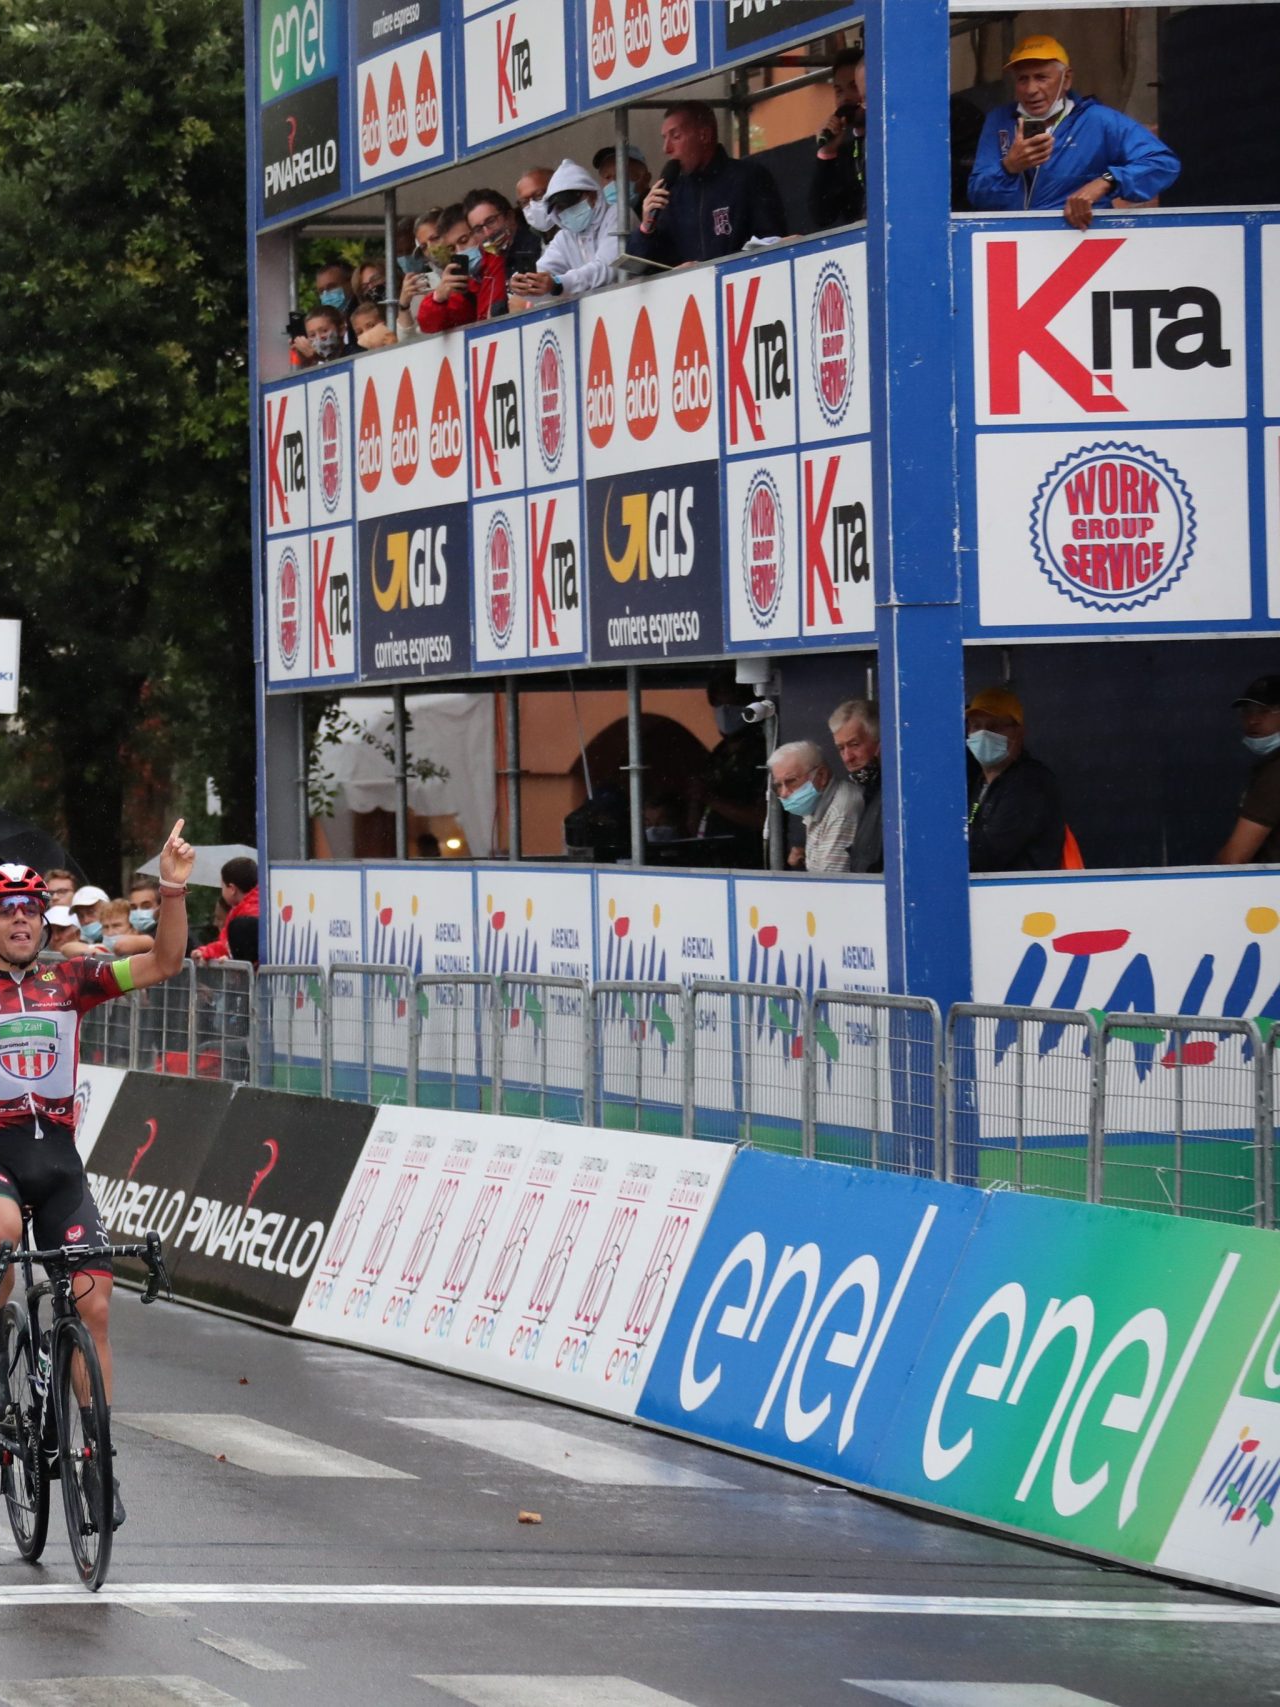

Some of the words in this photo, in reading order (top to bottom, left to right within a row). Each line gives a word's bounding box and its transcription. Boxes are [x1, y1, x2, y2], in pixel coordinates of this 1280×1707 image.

[592, 16, 616, 66] aido
[624, 8, 652, 53] aido
[264, 139, 337, 198] PINARELLO
[587, 370, 614, 430] aido
[626, 361, 659, 421] aido
[673, 350, 711, 413] aido
[358, 423, 382, 477] aido
[391, 415, 419, 469] aido
[430, 406, 462, 459] aido
[1064, 462, 1160, 516] WORK
[648, 487, 694, 579] GLS
[1072, 517, 1155, 540] GROUP
[409, 525, 447, 608] GLS
[1062, 541, 1165, 591] SERVICE
[375, 633, 408, 669] corriere
[409, 635, 451, 674] espresso
[608, 607, 648, 647] corriere
[650, 609, 699, 655] espresso
[329, 919, 351, 938] AGENZIA
[435, 923, 462, 942] AGENZIA
[551, 928, 580, 949] AGENZIA
[682, 937, 714, 960] AGENZIA
[435, 954, 470, 974] NAZIONALE
[842, 945, 875, 971] AGENZIA
[25, 1022, 43, 1032] Zalf
[174, 1196, 324, 1278] PINARELLO
[679, 1204, 938, 1456] enel
[922, 1252, 1241, 1530] enel
